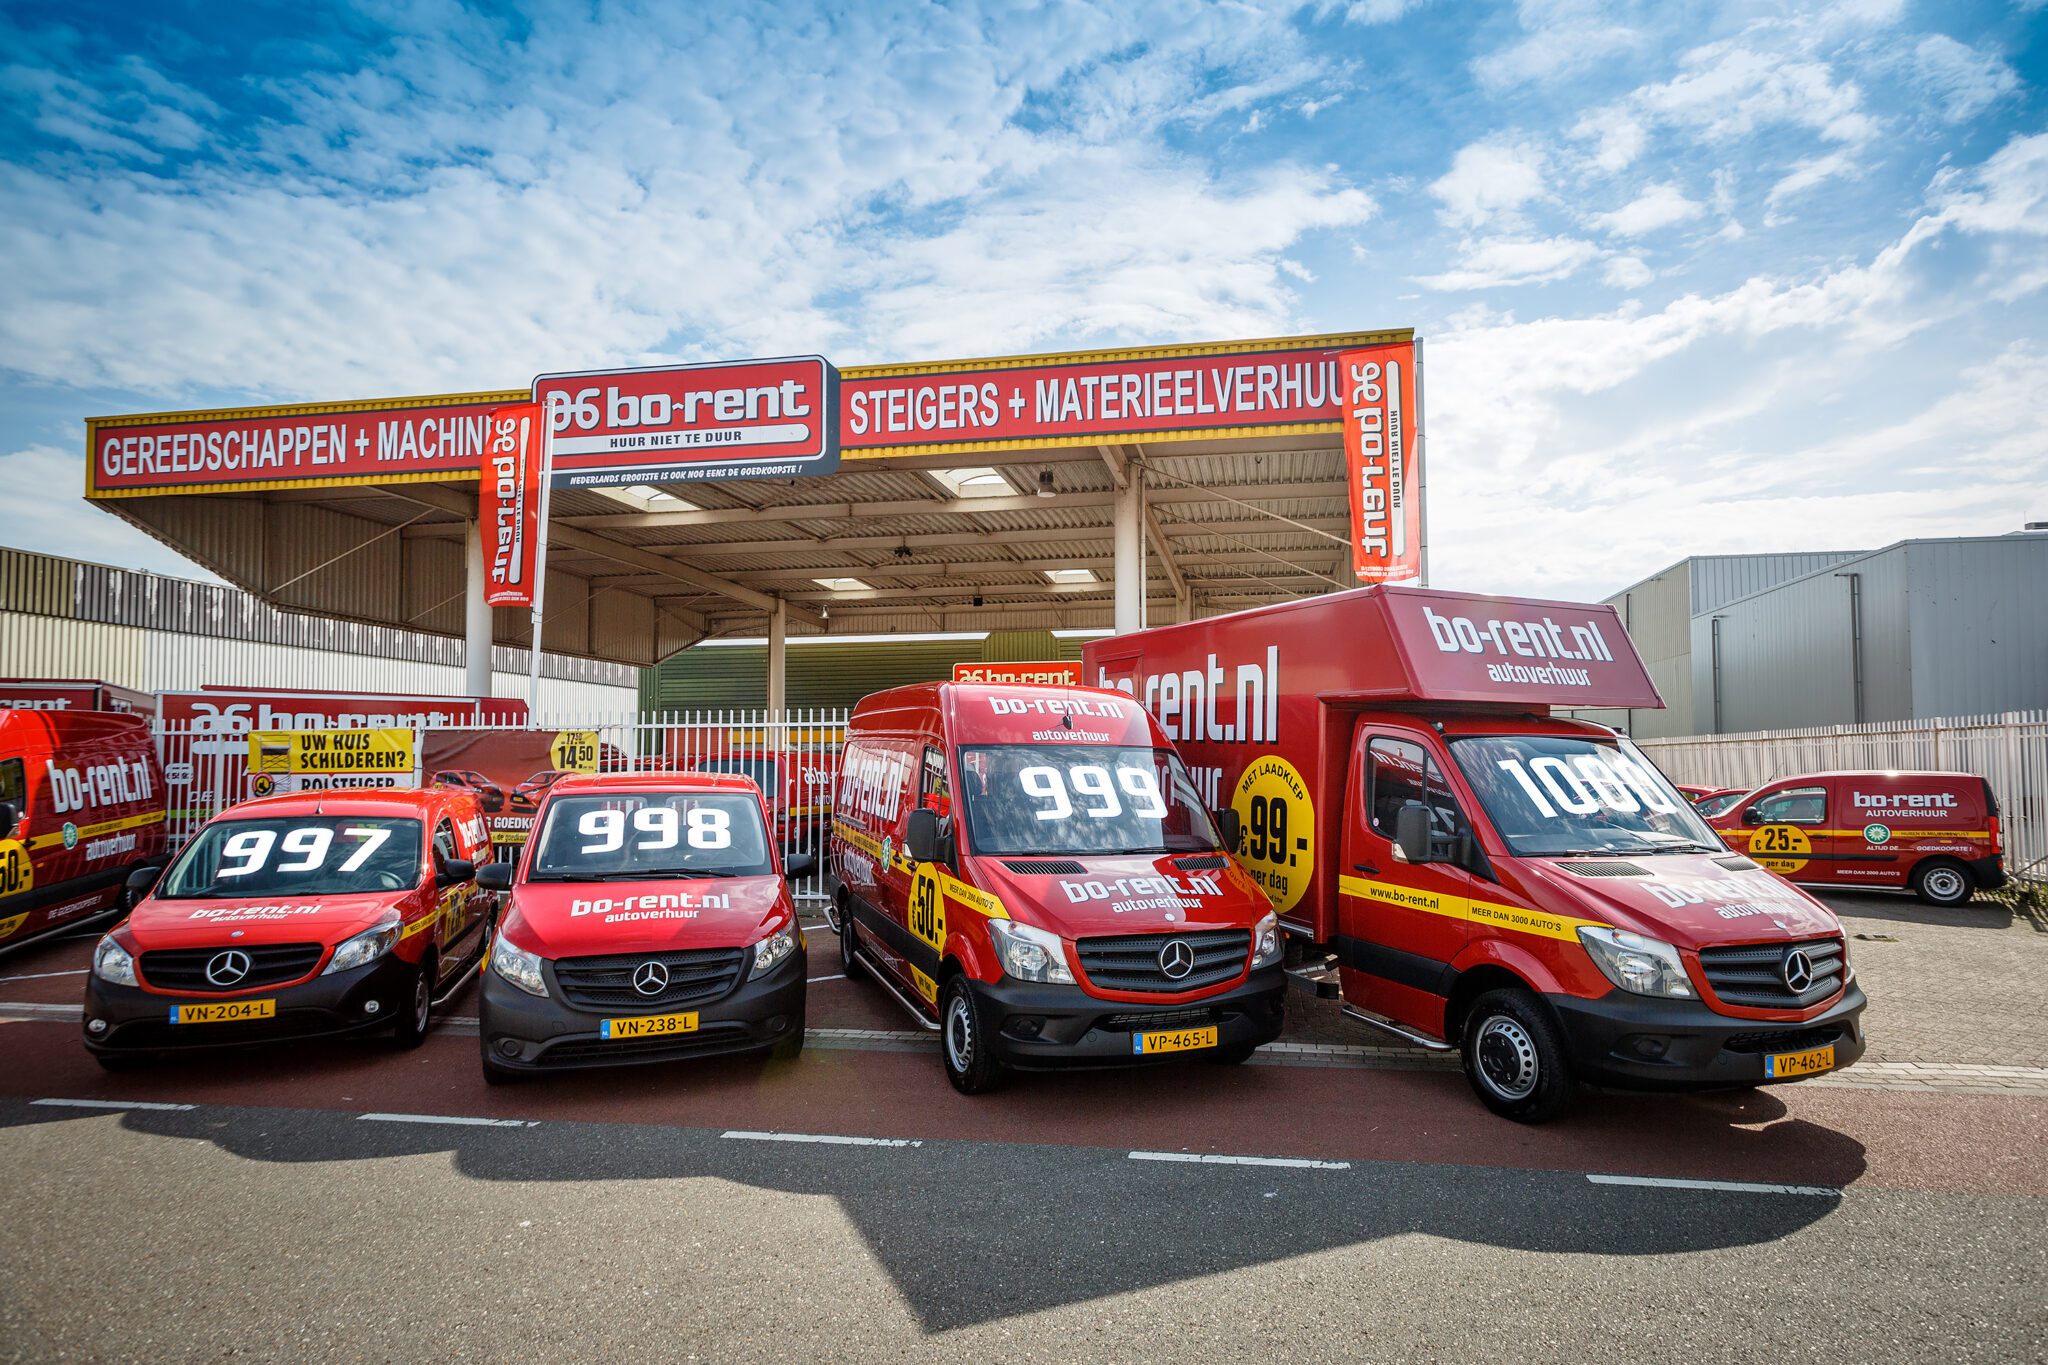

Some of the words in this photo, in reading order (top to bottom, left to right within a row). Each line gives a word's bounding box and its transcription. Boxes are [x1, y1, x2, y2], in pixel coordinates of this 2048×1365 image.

[607, 380, 810, 428] bo-rent
[849, 381, 999, 435] STEIGERS
[1035, 360, 1343, 424] MATERIEELVERHUU
[102, 423, 347, 476] GEREEDSCHAPPEN
[377, 415, 493, 462] MACHIN
[610, 436, 645, 448] HUUR
[651, 434, 682, 446] NIET
[685, 433, 701, 444] TE
[705, 431, 742, 442] DUUR
[570, 474, 619, 485] NEDERLANDS
[621, 472, 659, 482] GROOTSTE
[660, 471, 668, 480] IS
[670, 470, 686, 480] OOK
[688, 469, 704, 479] NOG
[706, 468, 726, 478] EENS
[728, 467, 739, 477] DE
[741, 465, 797, 476] GOEDKOOPSTE
[1422, 606, 1614, 662] bo-rent.nl
[1487, 662, 1591, 686] autoverhuur
[988, 696, 1125, 719] bo-rent.nl
[301, 734, 326, 751] UW
[333, 733, 370, 750] HUIS
[1031, 729, 1110, 743] autoverhuur
[301, 750, 406, 769] SCHILDEREN?
[46, 755, 152, 814] bo-rent.nl
[1019, 765, 1168, 821] 999
[1242, 769, 1257, 794] MET
[1259, 763, 1304, 801] LAADKLEP
[1497, 757, 1679, 818] 1000
[1854, 792, 1958, 807] bo-rent
[494, 817, 534, 829] GOEDKO
[1866, 809, 1948, 817] AUTOVERHUUR
[578, 807, 732, 855] 998
[216, 827, 392, 878] 997
[1781, 860, 1795, 869] dag
[1059, 874, 1224, 904] bo-rent.nl
[1270, 869, 1288, 896] dag
[571, 892, 729, 917] bo-rent.nl
[1112, 895, 1204, 913] autoverhuur
[1370, 886, 1439, 909] www.bo-rent.nl
[188, 905, 322, 920] bo-rent.nl
[210, 913, 288, 923] autoverhuur
[605, 909, 699, 923] autoverhuur
[1472, 907, 1492, 919] MEER
[1493, 911, 1509, 922] DAN
[1511, 914, 1528, 926] 3000
[1530, 918, 1561, 932] AUTO'S
[185, 1004, 270, 1021] VN-204-L
[616, 1016, 692, 1036] VN-238-L
[1148, 1030, 1213, 1051] VP-465-L
[1779, 1050, 1831, 1073] VP-462-L
